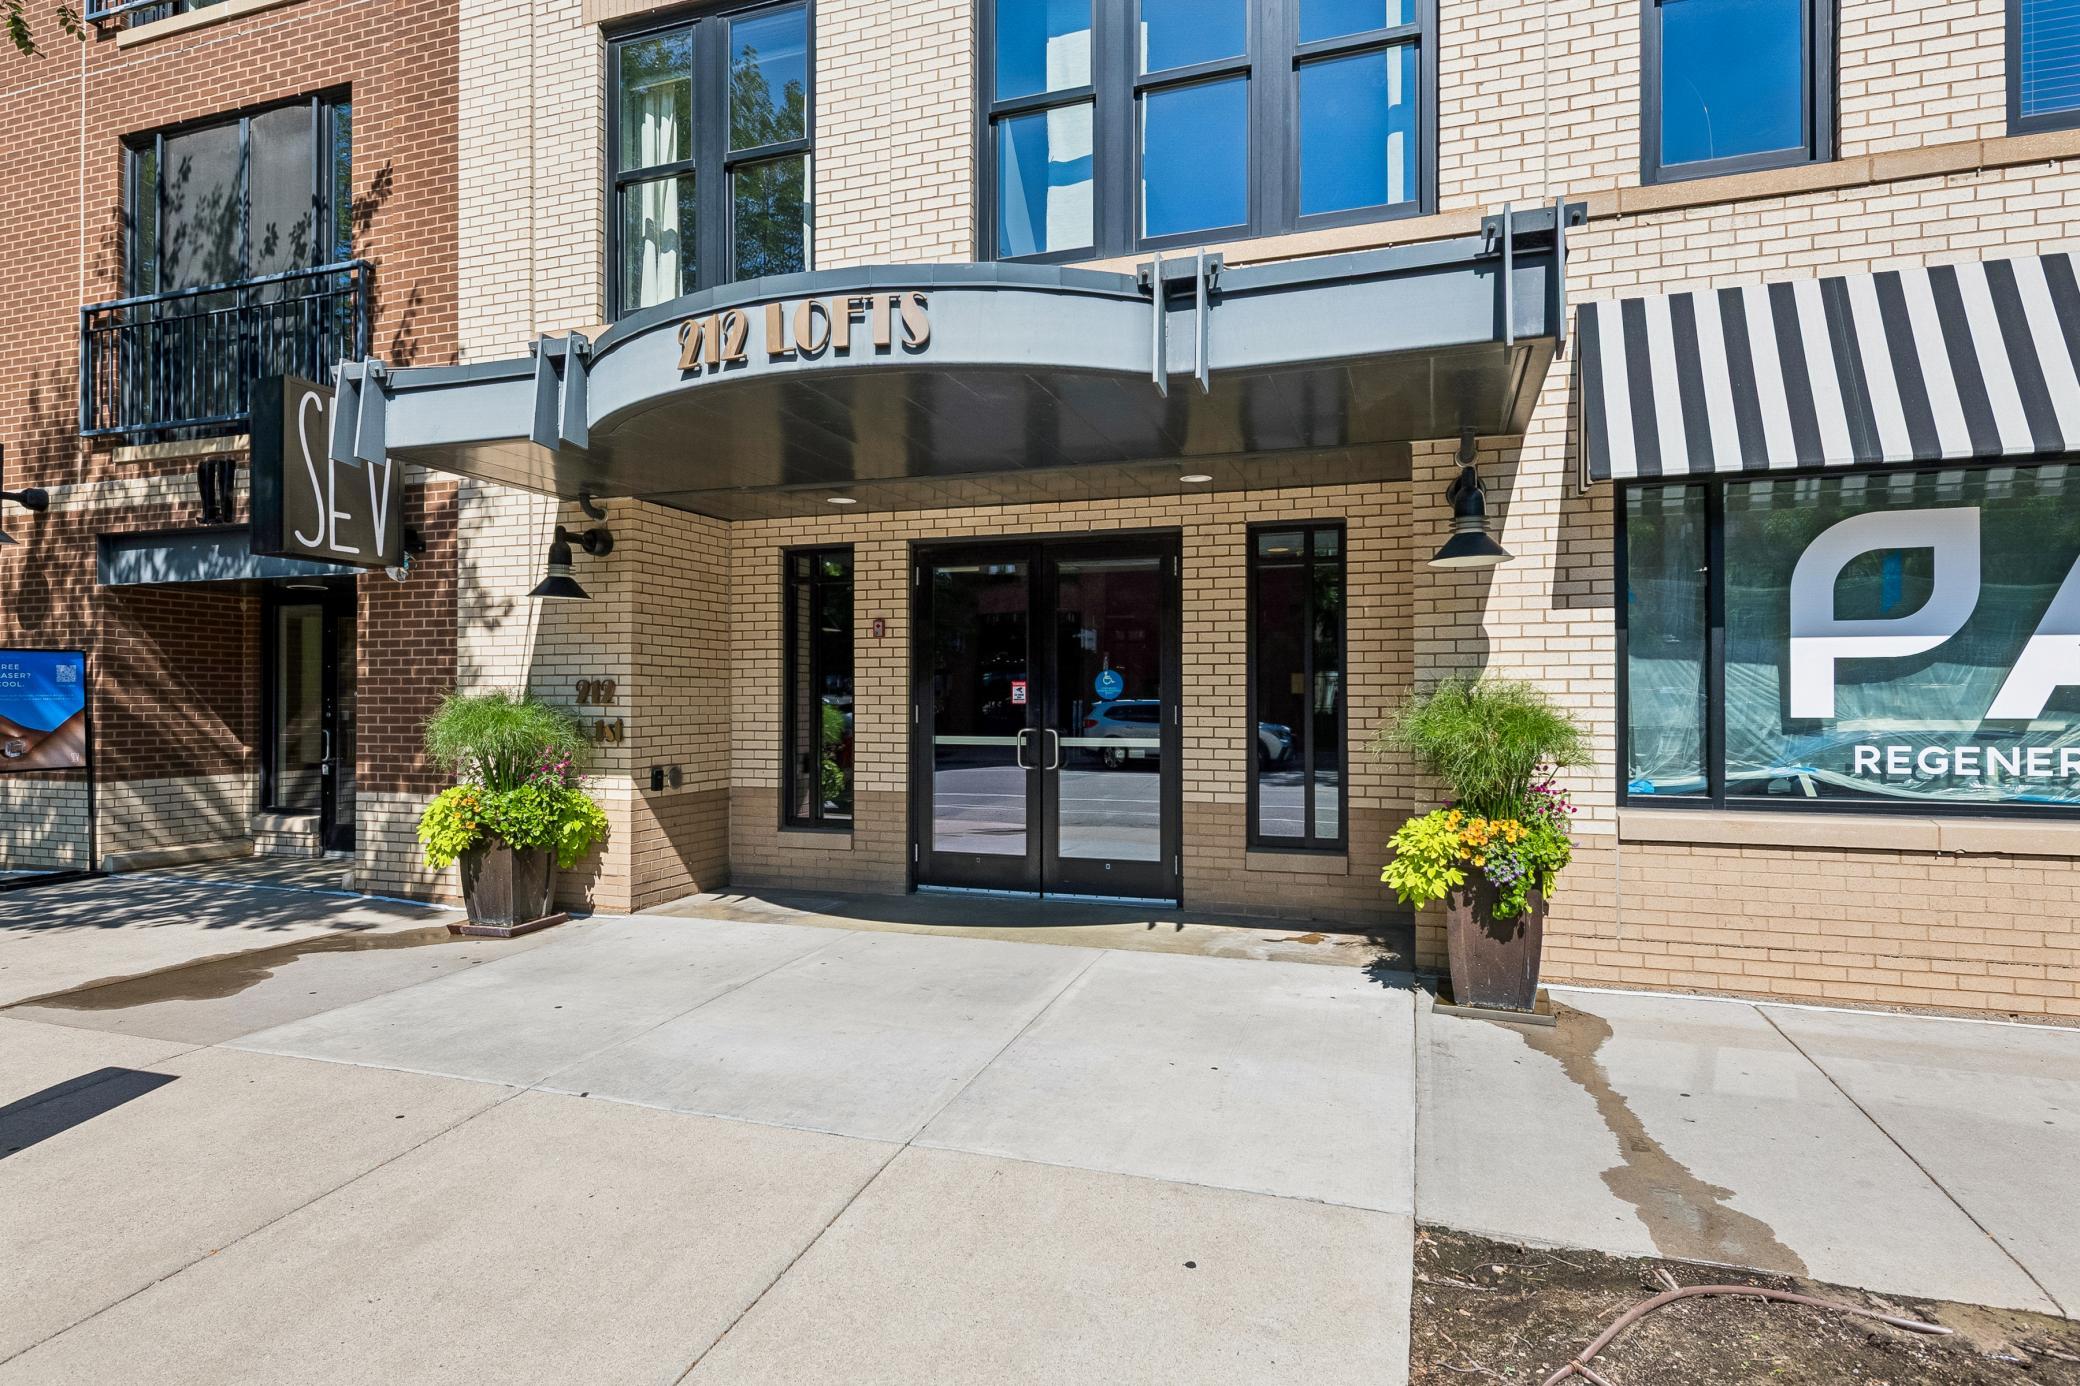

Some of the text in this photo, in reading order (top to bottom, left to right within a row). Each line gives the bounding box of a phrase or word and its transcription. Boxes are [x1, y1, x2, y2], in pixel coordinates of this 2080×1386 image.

[677, 290, 931, 370] 212 LOFTS
[575, 679, 616, 704] 212
[1854, 745, 2080, 777] REGENER
